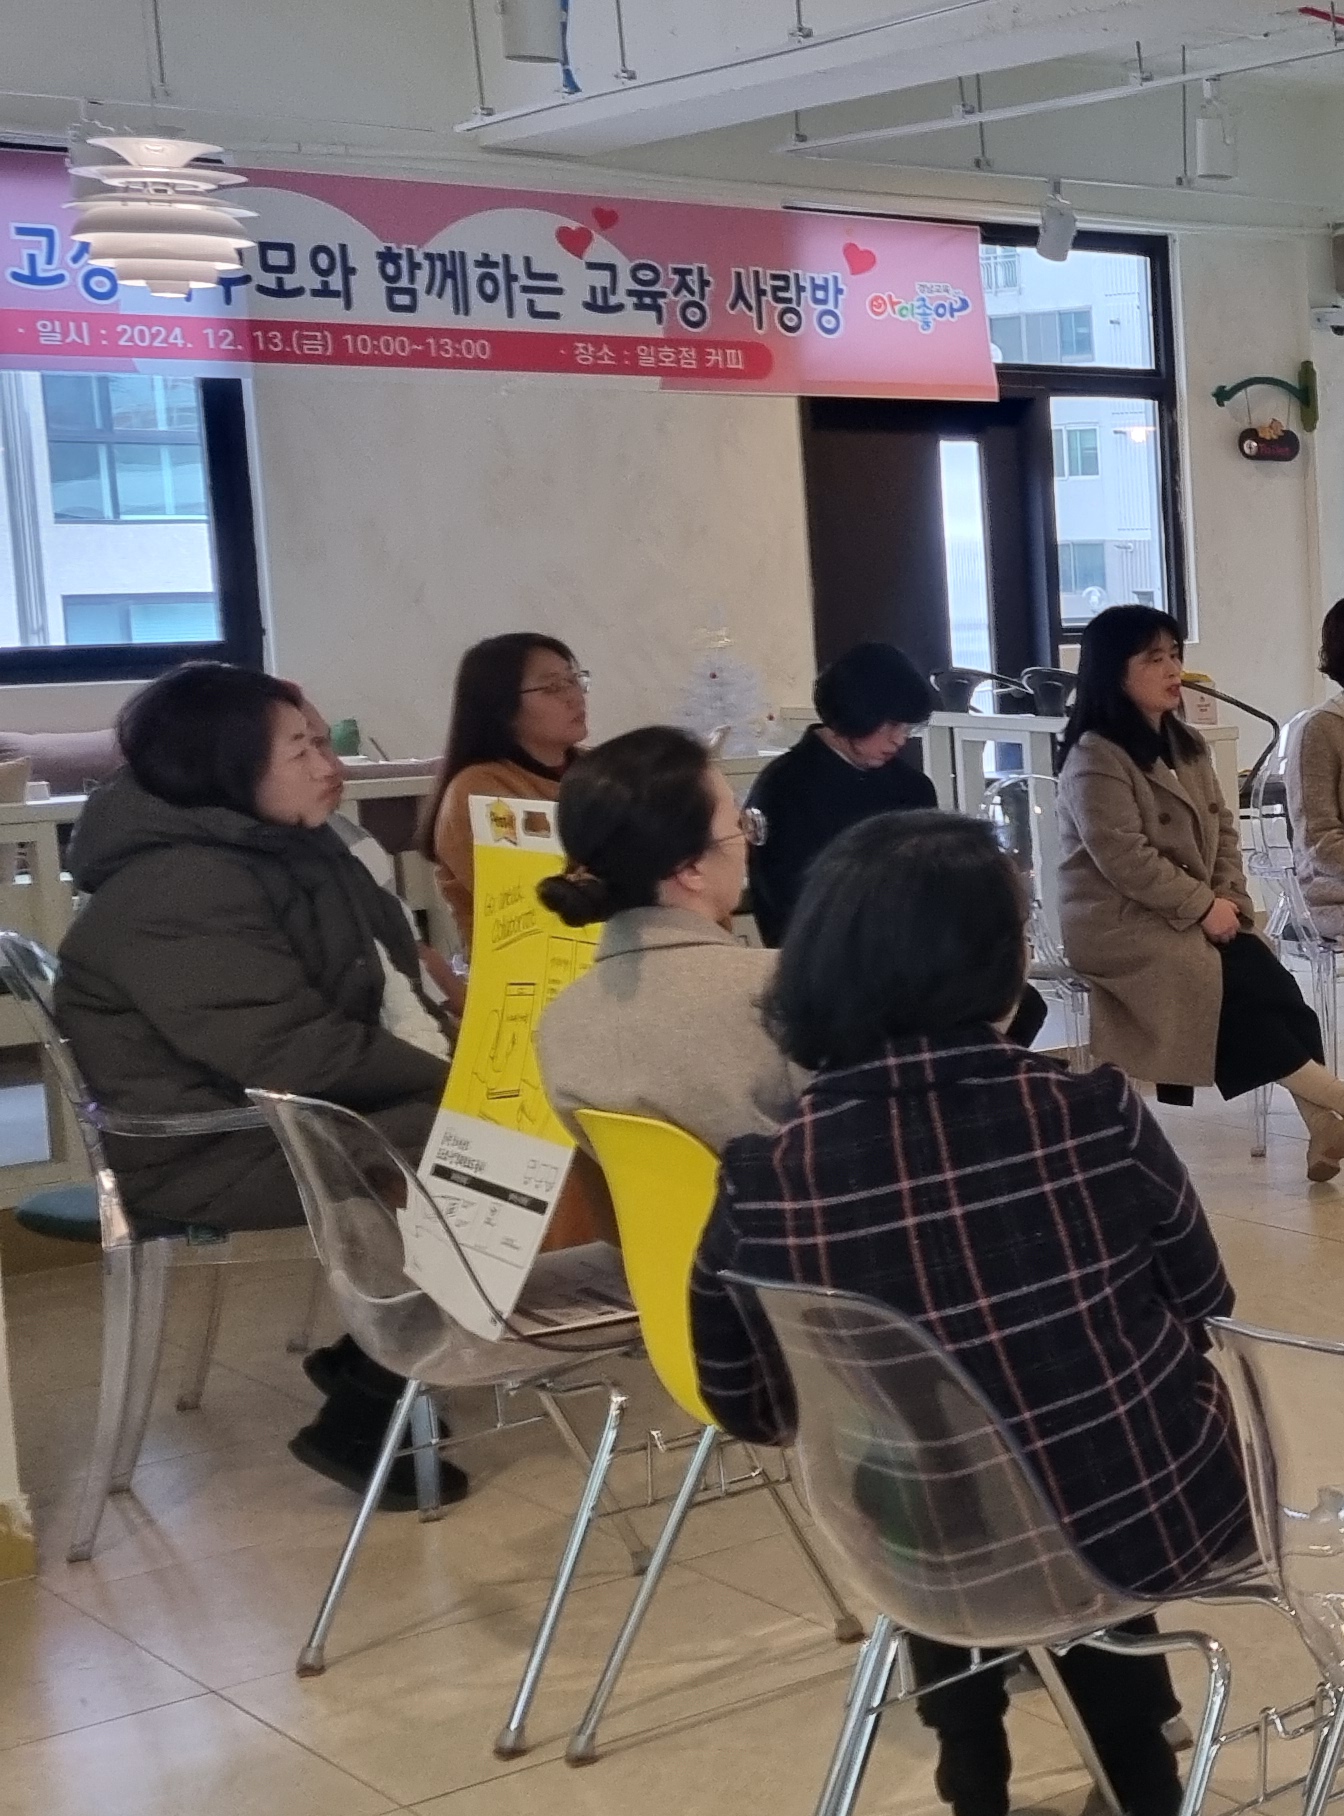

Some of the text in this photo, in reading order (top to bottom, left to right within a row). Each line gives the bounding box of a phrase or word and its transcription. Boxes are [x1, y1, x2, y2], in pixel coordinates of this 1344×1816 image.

[376, 242, 565, 320] 함께하는
[582, 258, 711, 333] 교육장
[727, 266, 847, 338] 사랑방
[869, 292, 970, 332] 아이좋아
[37, 319, 90, 347] 일시
[116, 323, 193, 348] 2024.
[203, 327, 243, 350] 12.
[343, 332, 491, 361] 10:00~13:00
[574, 340, 617, 367] 장소
[636, 344, 698, 371] 일호점
[705, 346, 745, 371] 커피
